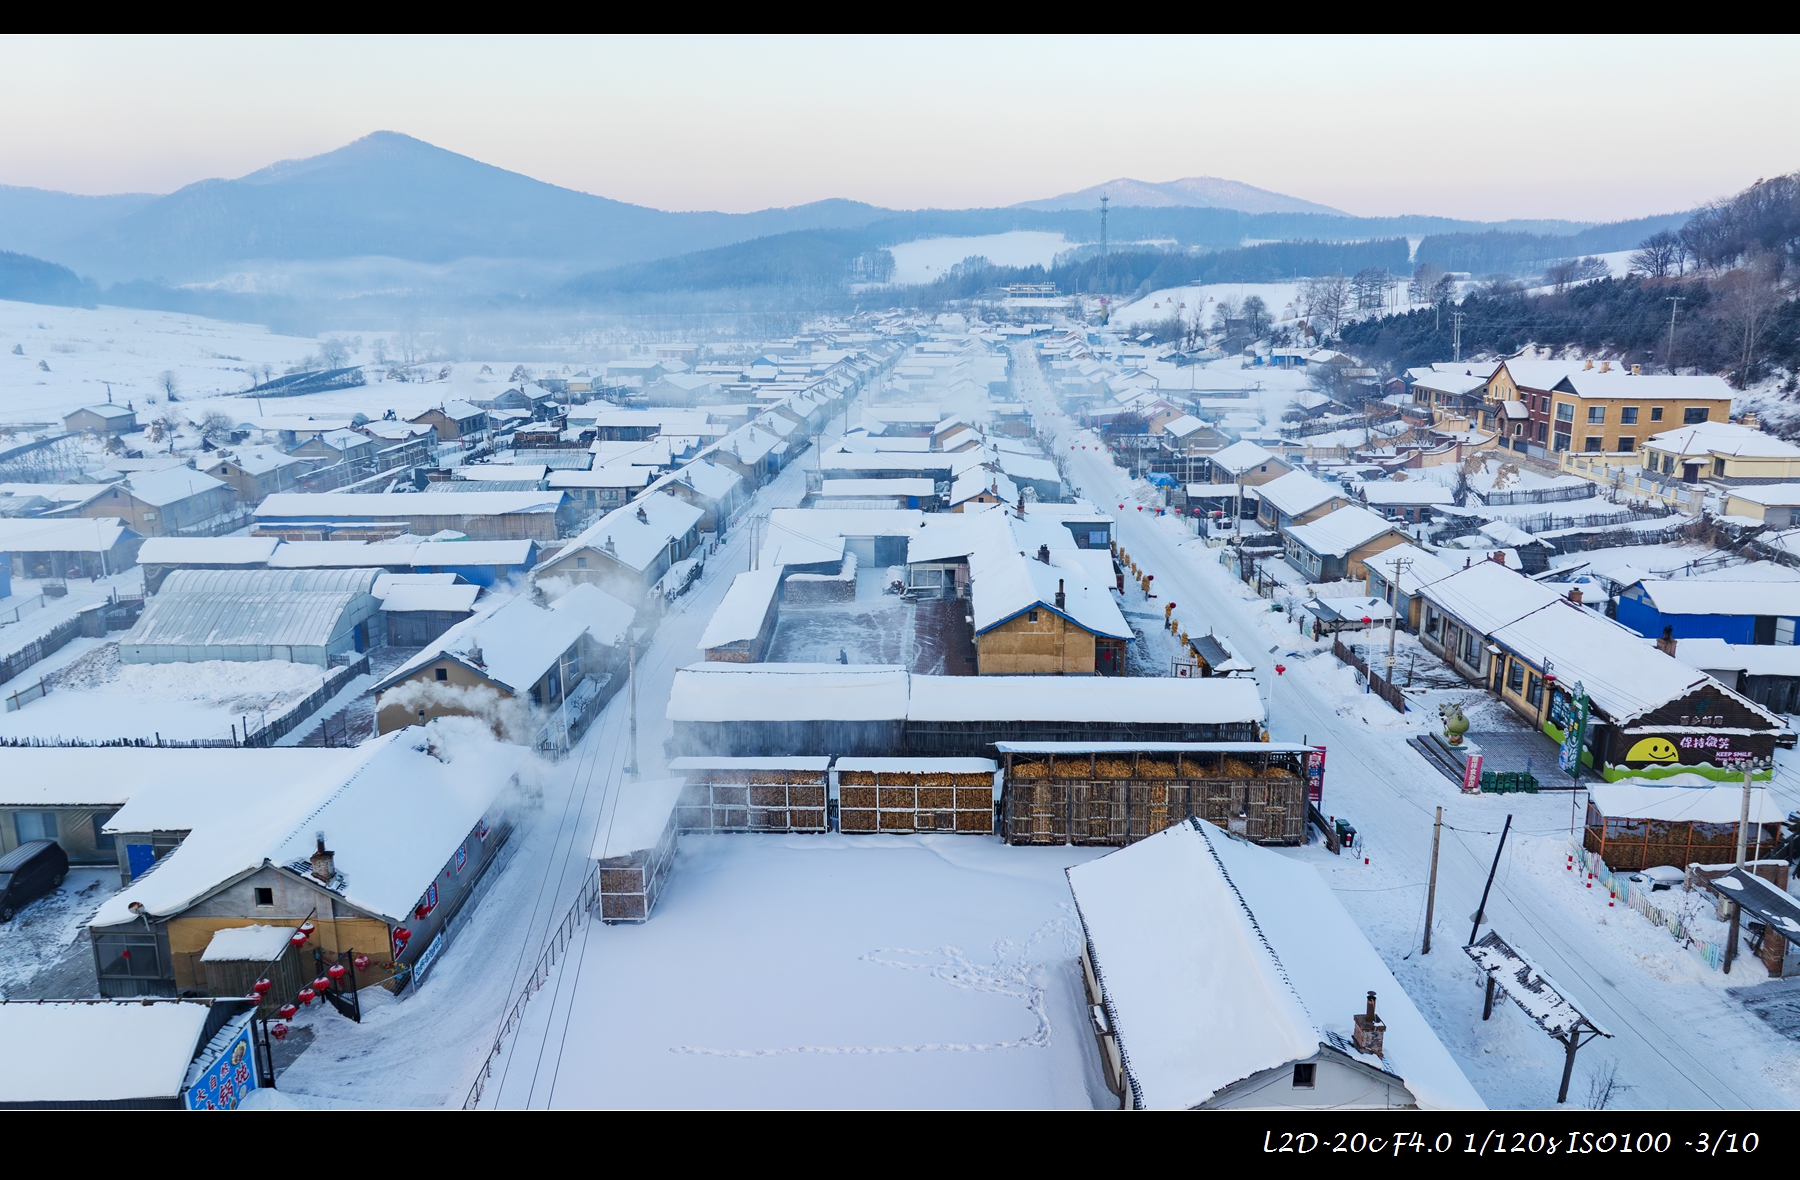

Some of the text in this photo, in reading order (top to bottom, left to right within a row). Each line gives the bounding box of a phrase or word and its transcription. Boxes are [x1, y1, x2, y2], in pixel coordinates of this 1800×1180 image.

[1680, 716, 1723, 725] 雪乡邮局
[1680, 735, 1730, 749] 保持微笑
[195, 1061, 230, 1108] 大自然
